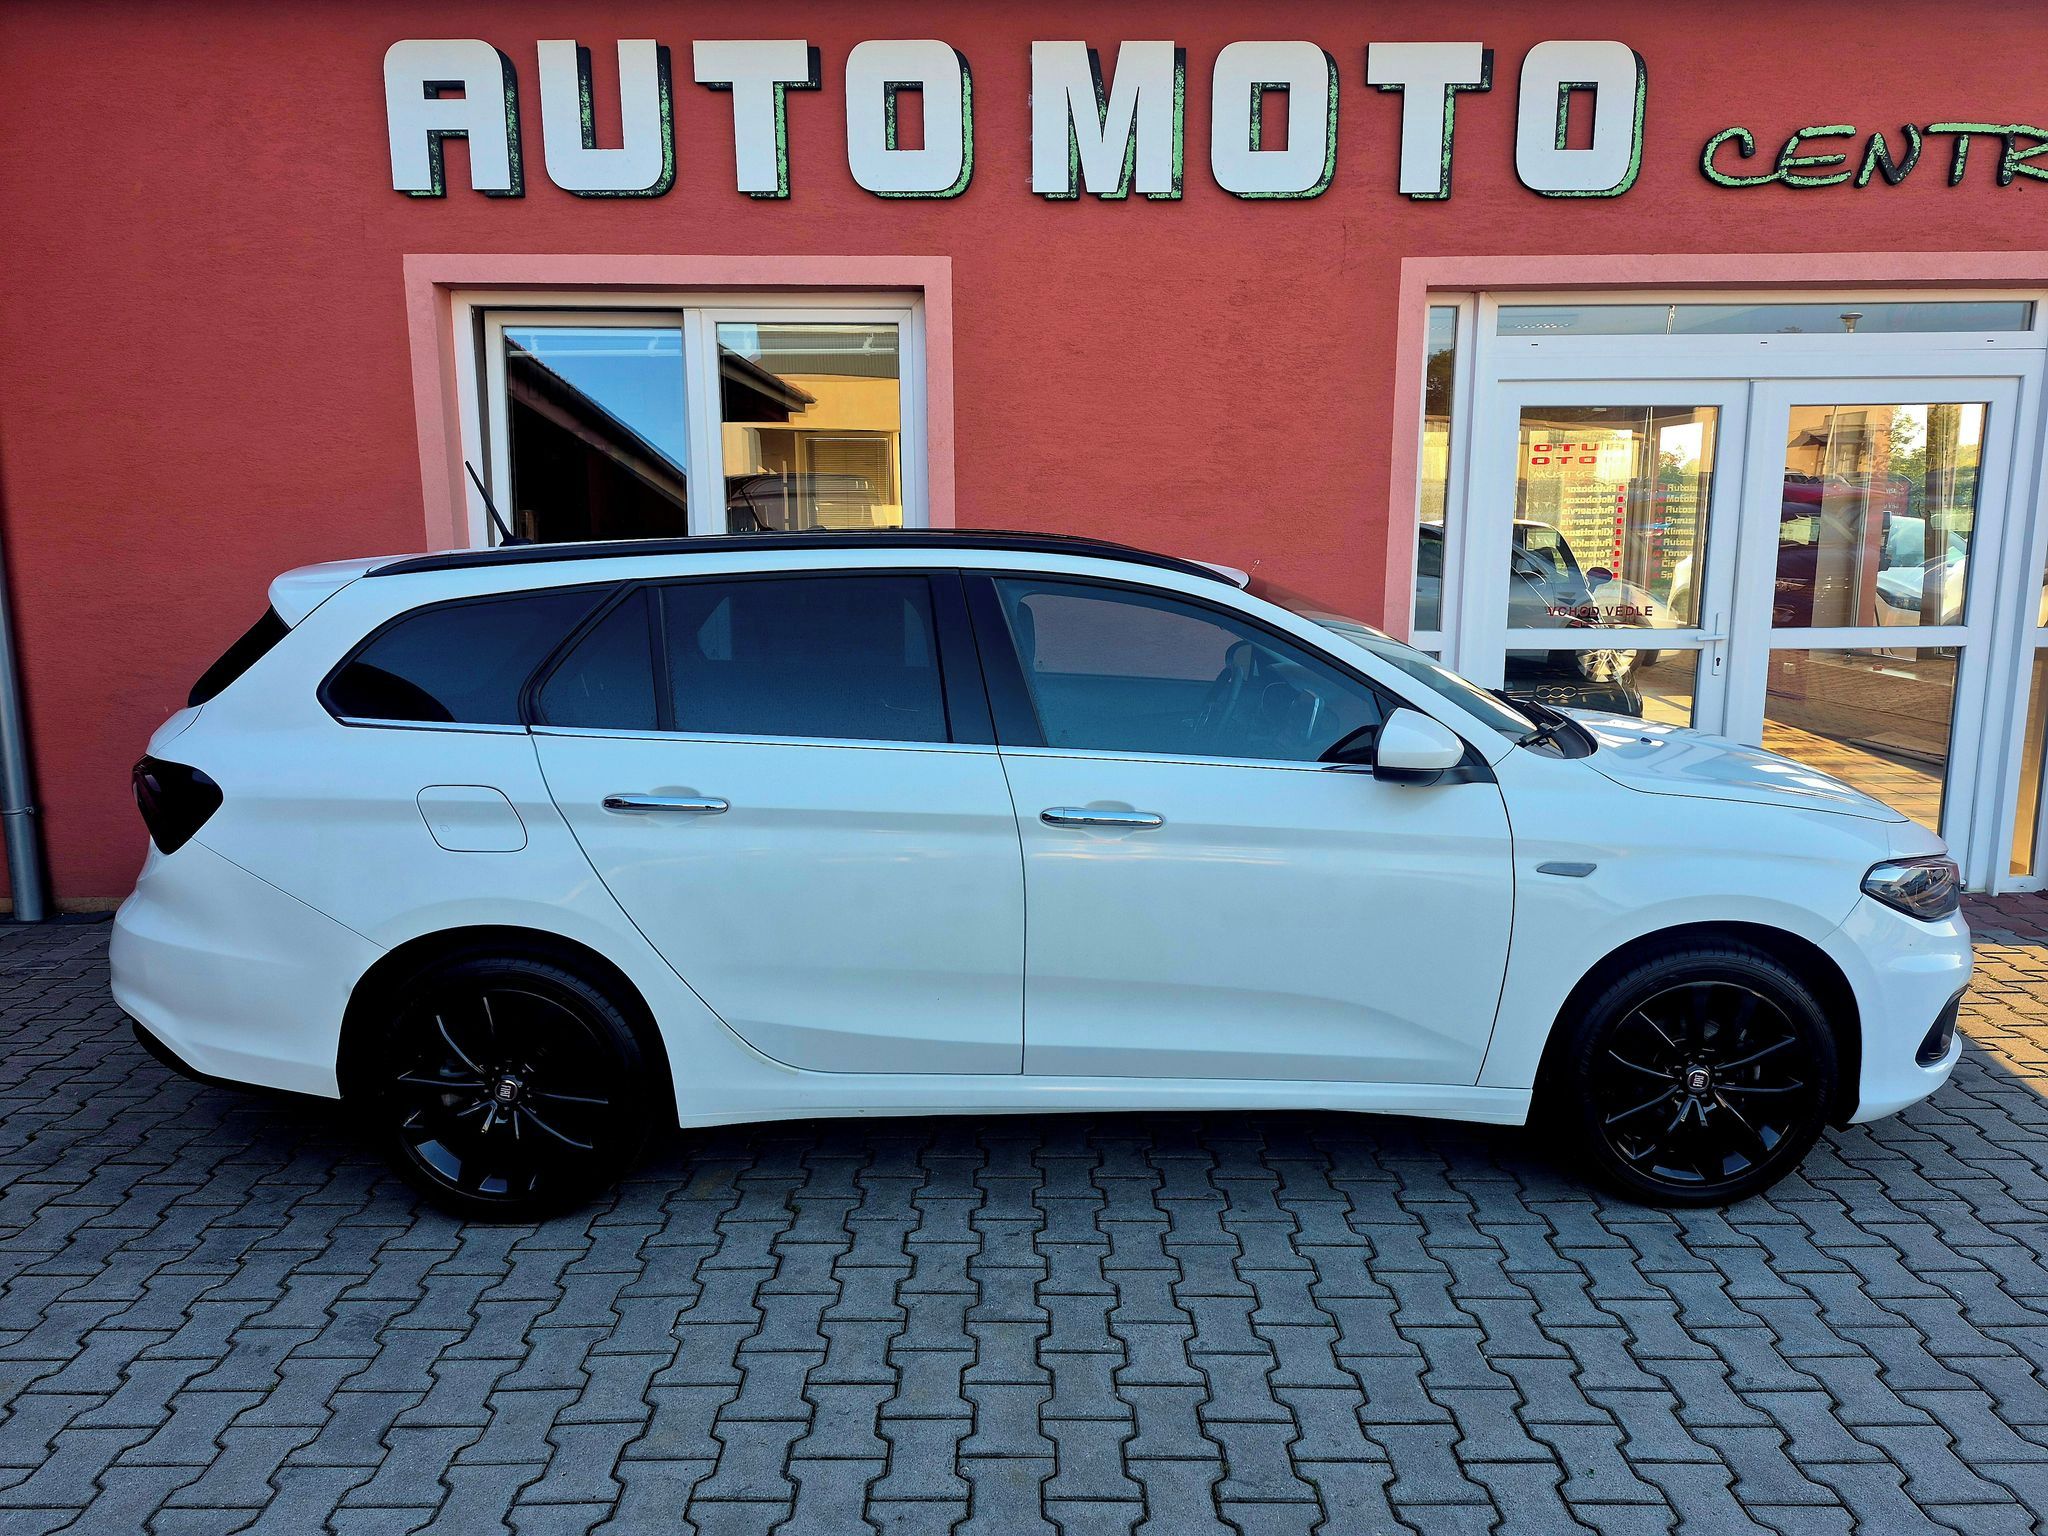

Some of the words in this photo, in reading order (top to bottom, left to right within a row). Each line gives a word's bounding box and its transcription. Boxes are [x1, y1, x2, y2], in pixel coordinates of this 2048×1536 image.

[383, 39, 974, 199] AUTO
[1030, 40, 1647, 200] MOTO
[1700, 121, 2048, 188] CENTR
[1547, 605, 1600, 617] VCHOD
[1605, 605, 1653, 617] VEDLE
